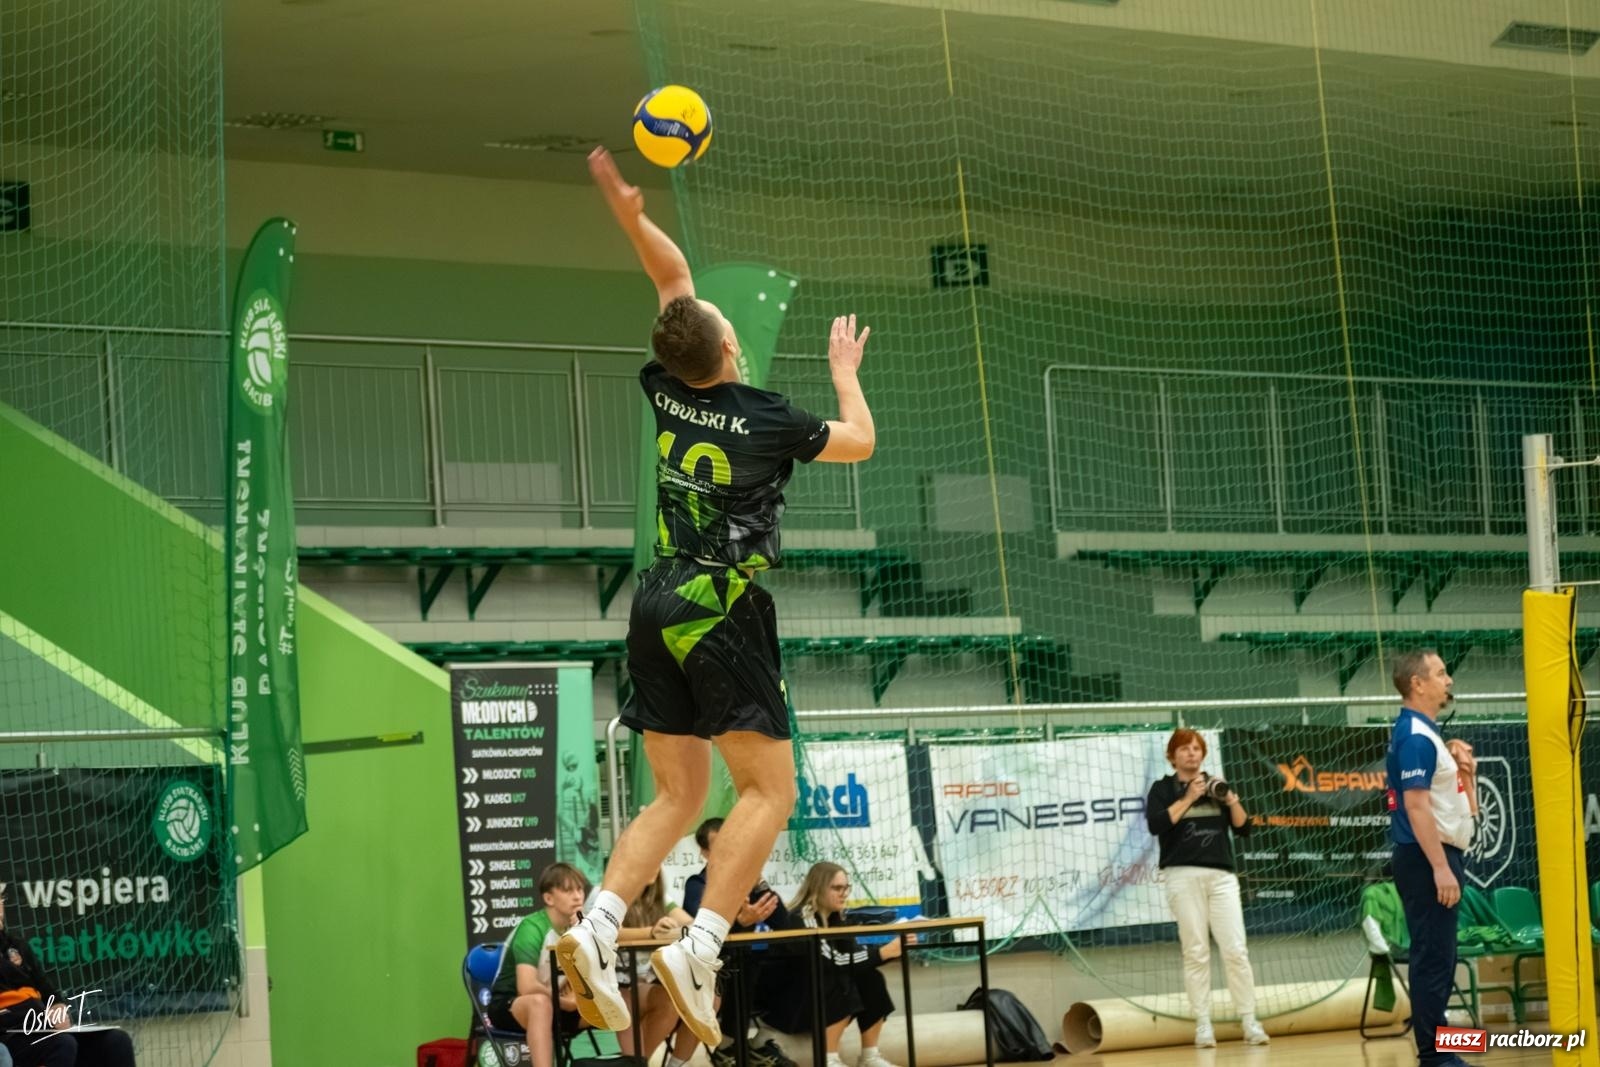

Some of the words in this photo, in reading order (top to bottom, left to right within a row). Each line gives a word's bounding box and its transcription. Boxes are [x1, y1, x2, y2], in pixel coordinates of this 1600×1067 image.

[655, 391, 726, 431] CYBULSKI
[730, 416, 750, 435] K.
[460, 678, 529, 701] Szukamy
[230, 676, 250, 765] KLUB
[461, 700, 527, 725] MŁODYCH
[463, 724, 545, 741] TALENTÓW
[1317, 771, 1388, 792] SPAW
[484, 792, 512, 805] KADECI
[485, 816, 524, 830] JUNIORZY
[946, 797, 1148, 835] VANESSA
[489, 859, 516, 872] SINGLE
[23, 867, 170, 915] wspiera
[490, 876, 520, 891] DWÓJKI
[491, 895, 519, 910] TRÓJKI
